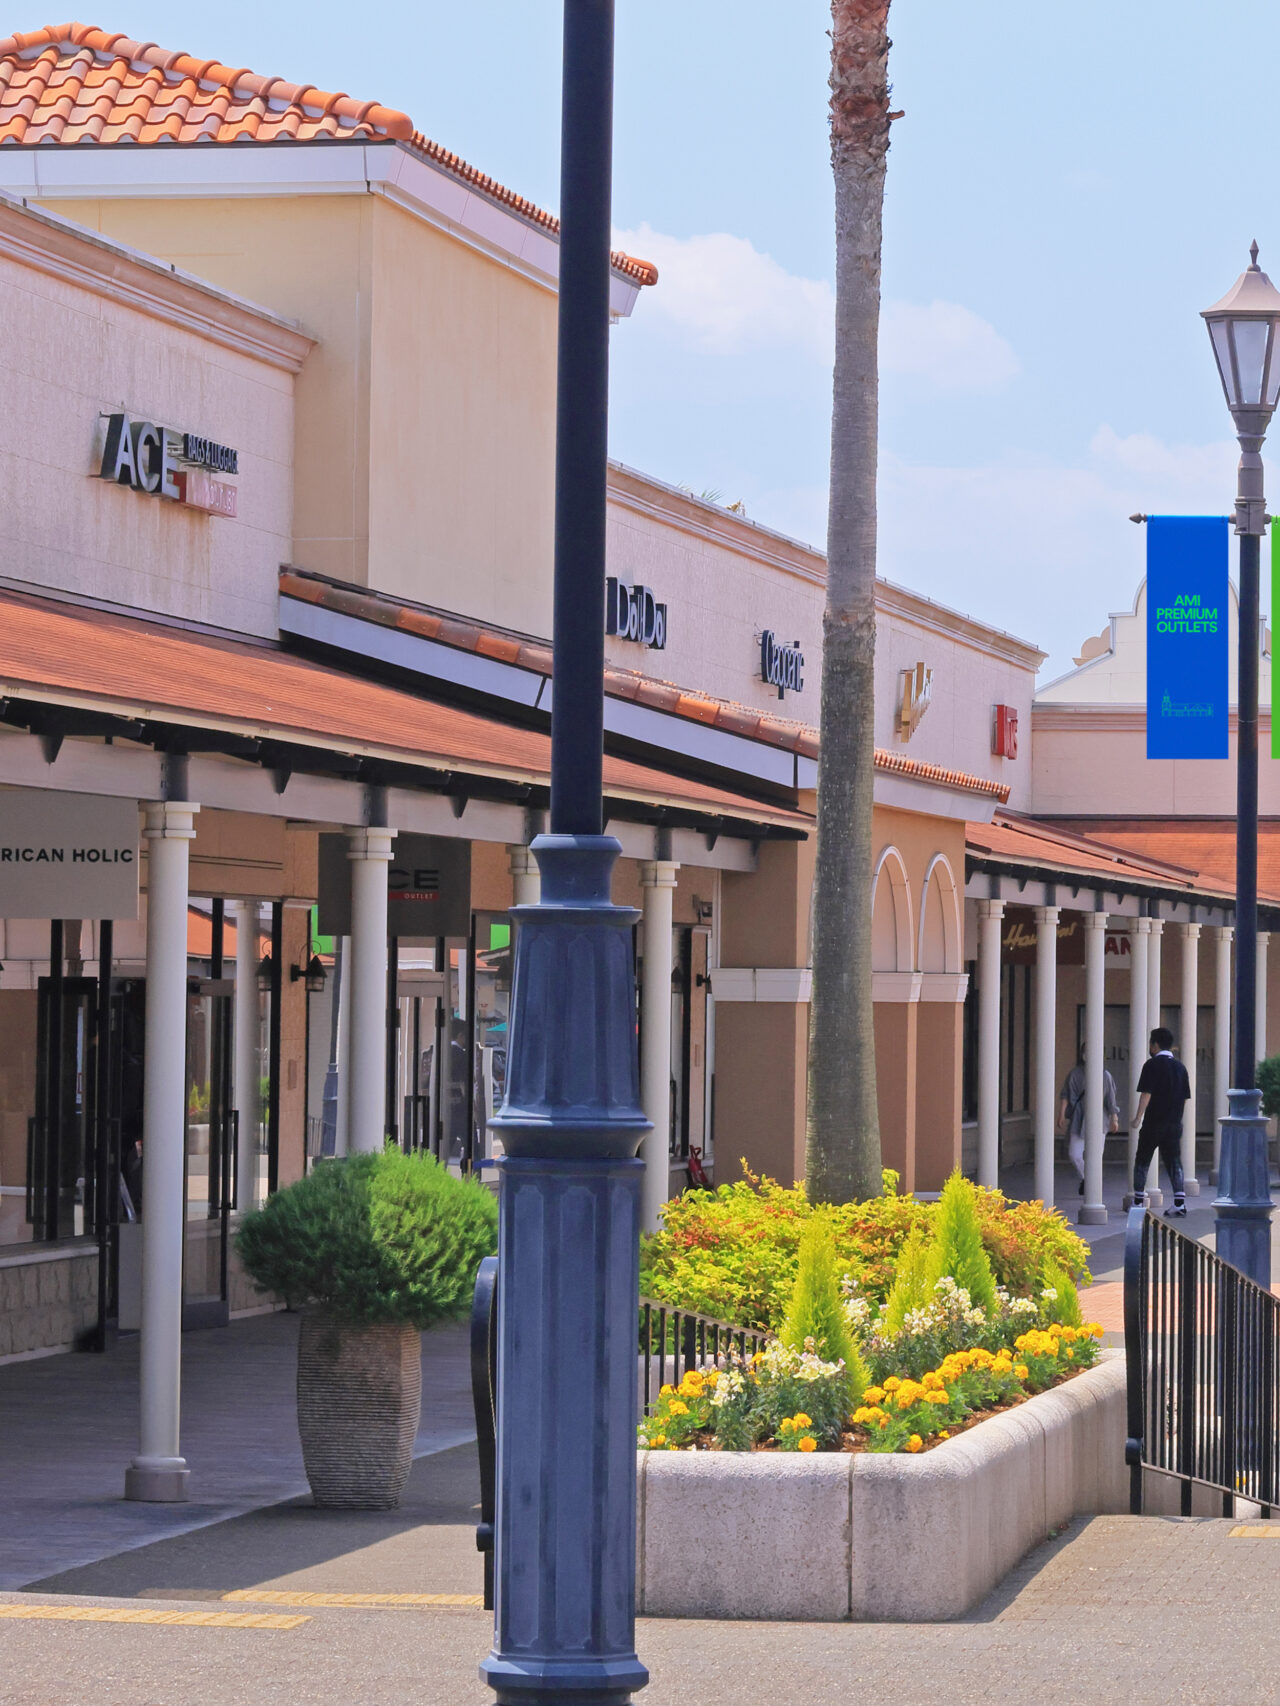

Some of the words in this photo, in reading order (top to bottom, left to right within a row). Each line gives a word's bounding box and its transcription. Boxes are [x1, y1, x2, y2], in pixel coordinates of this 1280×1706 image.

[187, 433, 206, 462] BAGS
[109, 412, 180, 500] ACE
[1174, 594, 1201, 607] AMI
[1156, 607, 1218, 620] PREMIUM
[1156, 620, 1218, 633] OUTLETS
[72, 848, 134, 863] HOLIC
[388, 869, 439, 890] CE
